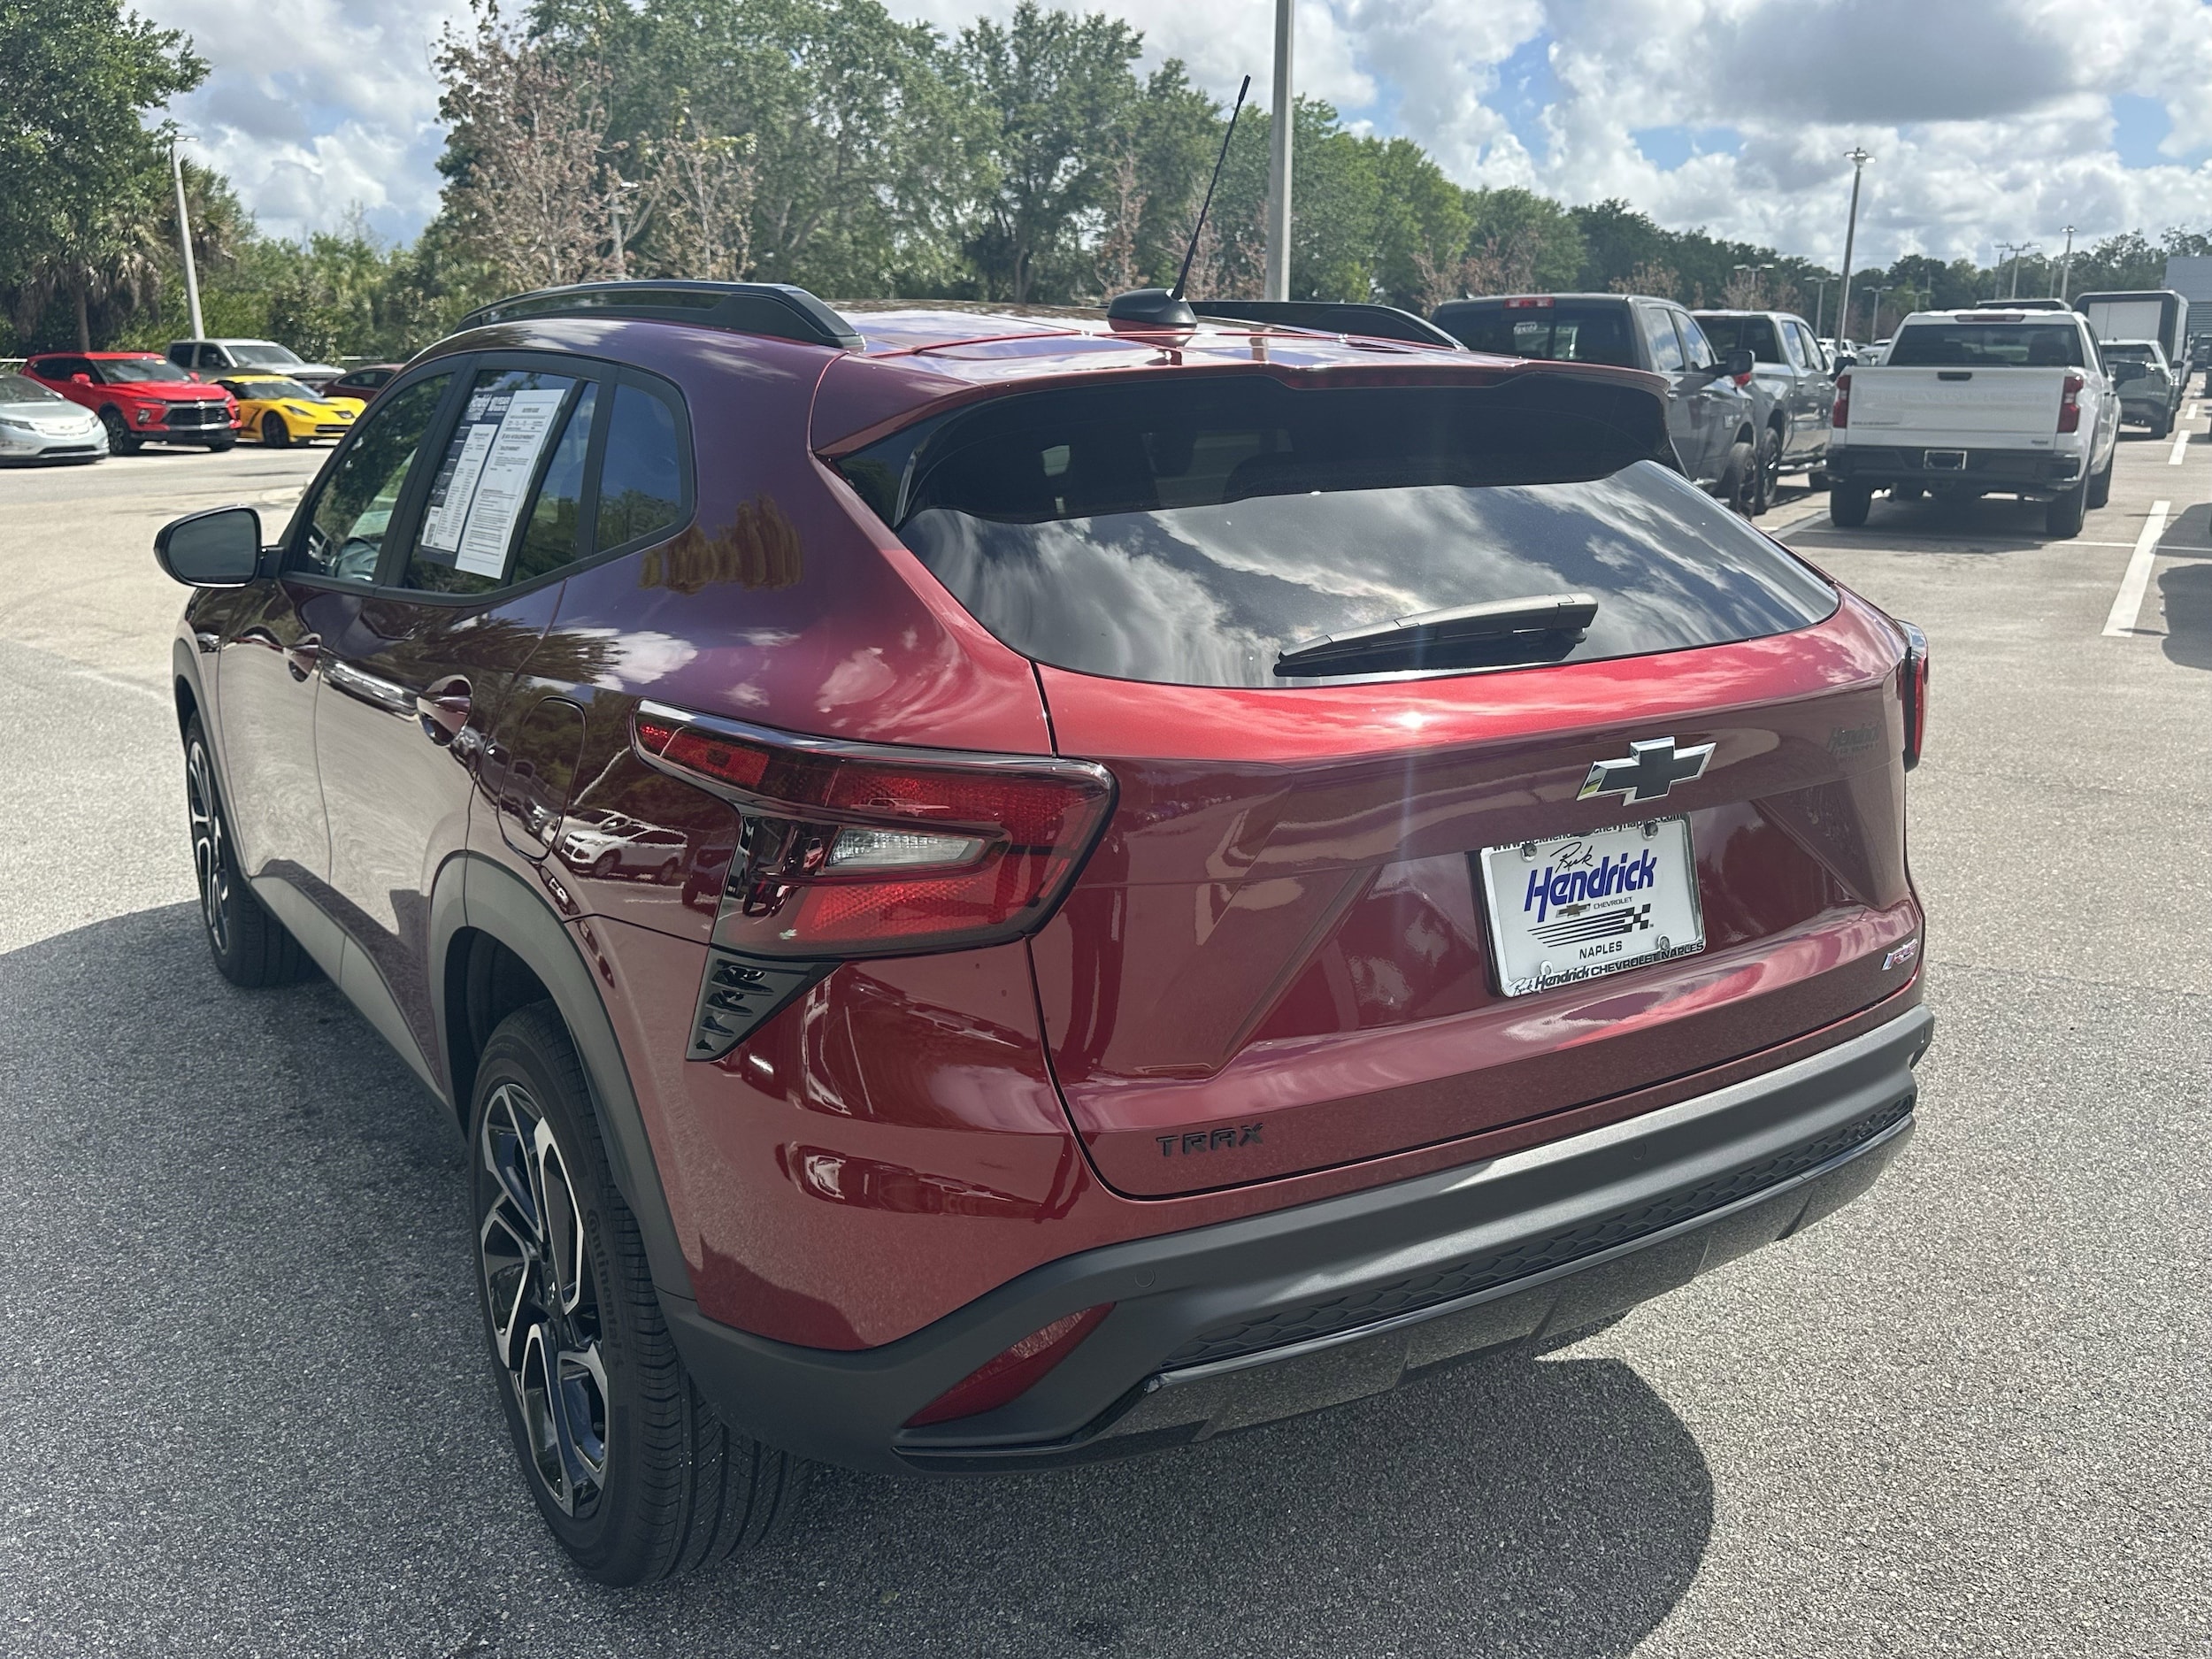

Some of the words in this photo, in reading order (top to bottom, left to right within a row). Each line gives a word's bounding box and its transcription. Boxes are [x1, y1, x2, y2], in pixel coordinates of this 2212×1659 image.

[1524, 849, 1657, 923] Hendrick
[1594, 896, 1633, 910] CHEVROLET
[1579, 941, 1623, 960] NAPLES
[1534, 965, 1591, 994] Hendrick
[1591, 952, 1658, 976] CHEVROLET
[1660, 941, 1704, 960] NAPLES
[1156, 1123, 1263, 1156] TRAX
